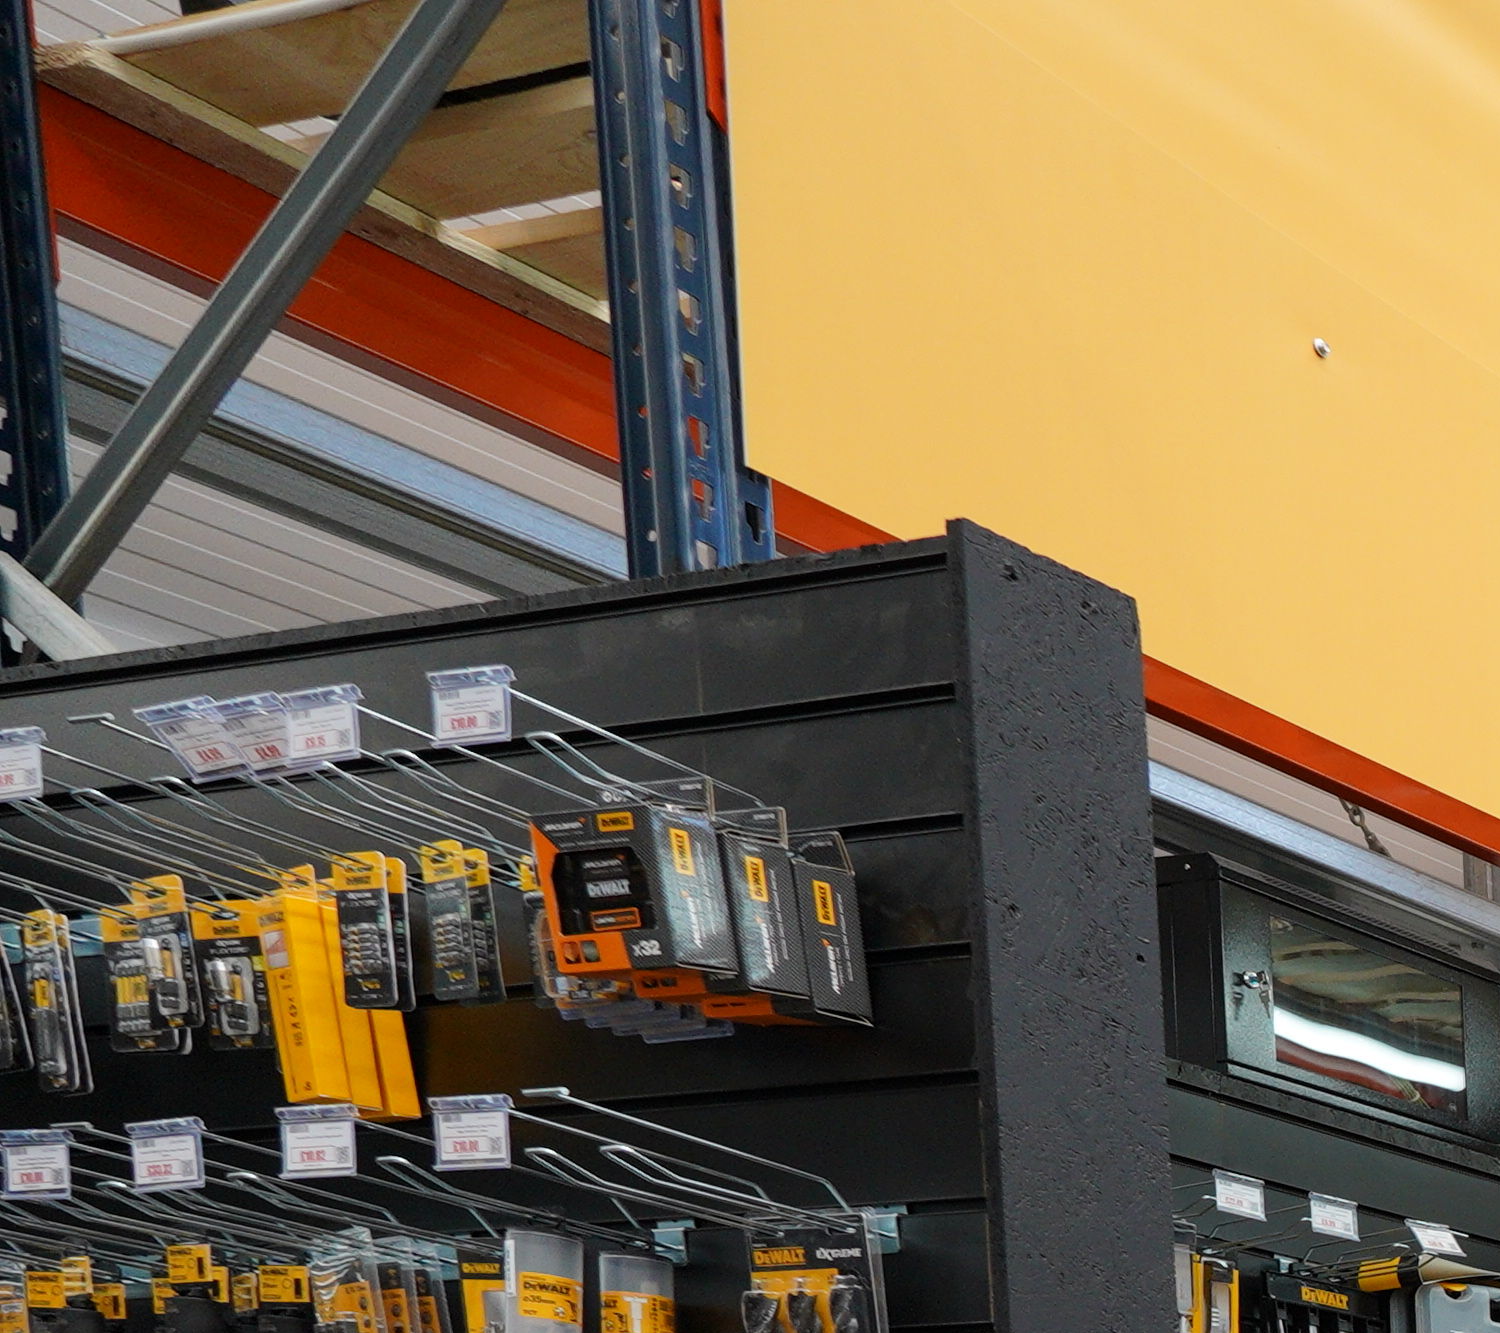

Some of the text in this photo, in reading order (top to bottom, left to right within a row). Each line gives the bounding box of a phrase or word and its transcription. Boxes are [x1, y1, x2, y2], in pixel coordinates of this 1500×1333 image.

[587, 878, 631, 898] DEWALT
[753, 1248, 806, 1267] DEWALT
[522, 1280, 572, 1297] DEWALT
[1301, 1286, 1349, 1310] DEWALT
